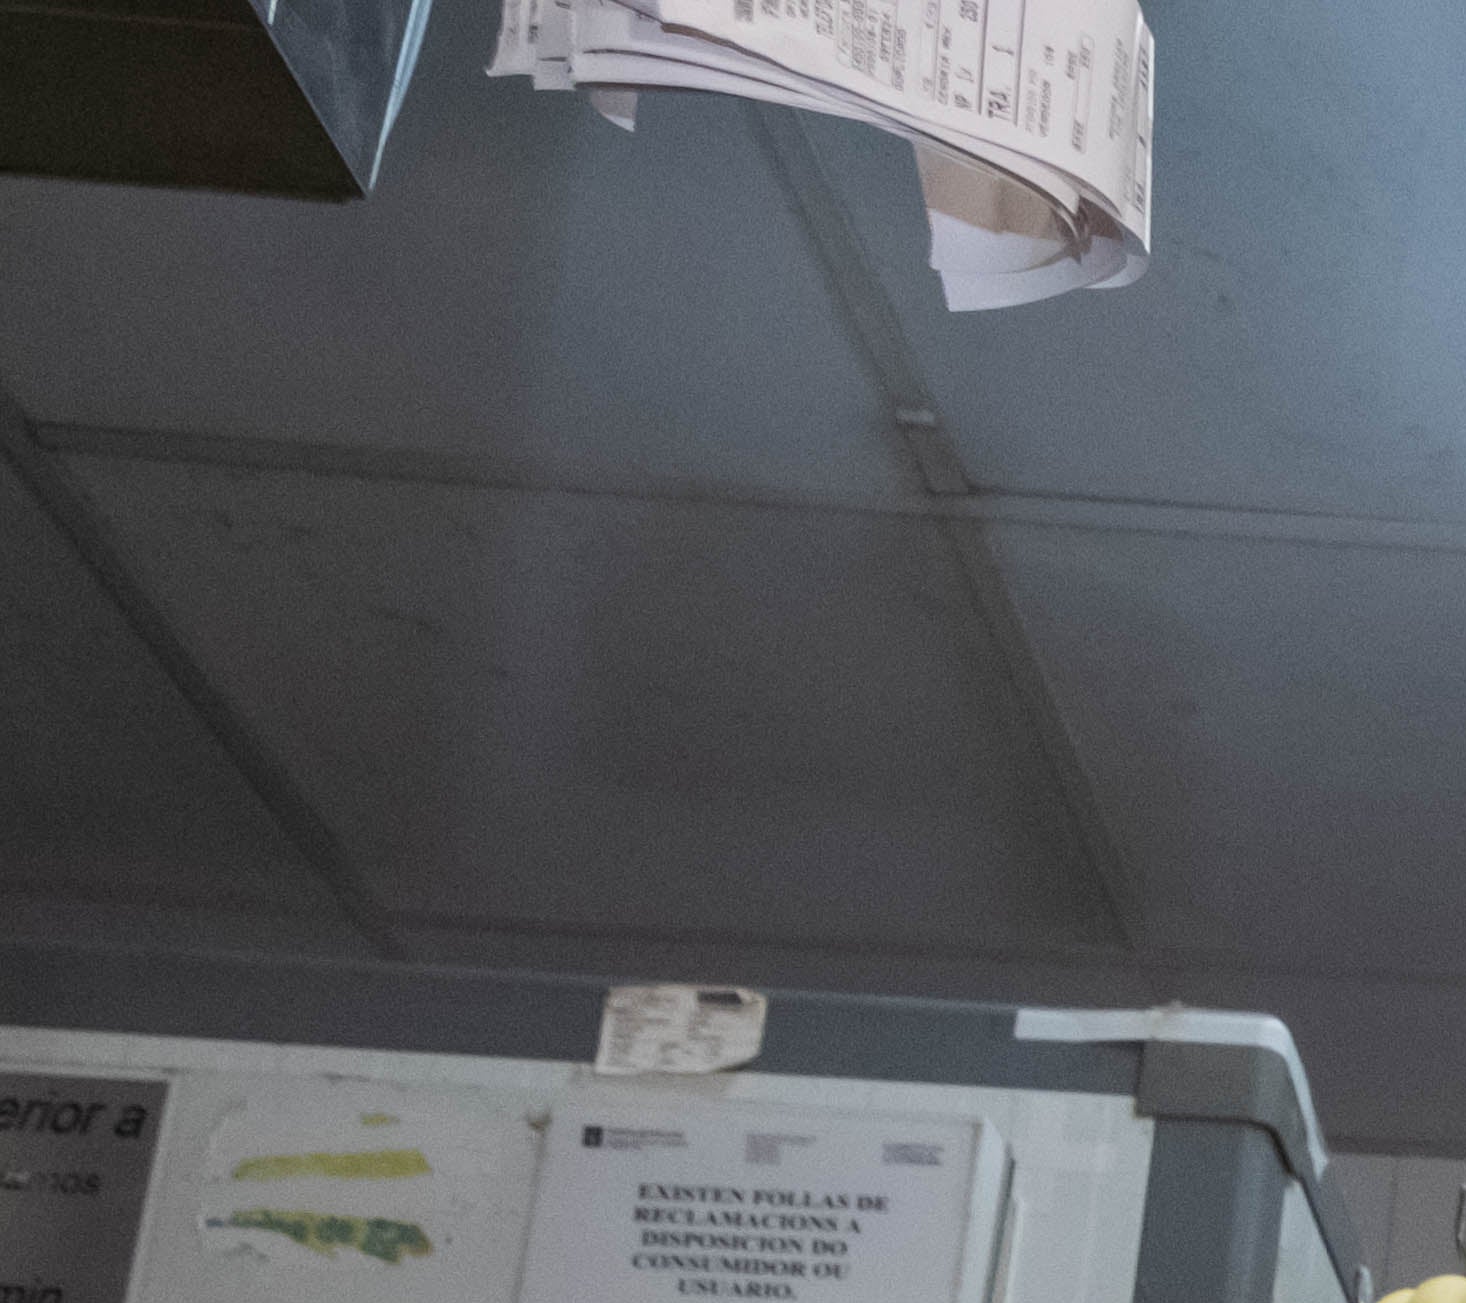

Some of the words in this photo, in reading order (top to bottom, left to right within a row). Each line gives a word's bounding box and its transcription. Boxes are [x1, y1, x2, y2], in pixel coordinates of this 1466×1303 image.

[113, 1104, 147, 1138] a
[637, 1183, 744, 1204] EXISTEN
[752, 1188, 850, 1210] FOLLAS
[856, 1194, 890, 1213] DE
[633, 1205, 840, 1233] RECLAMACIONS
[846, 1217, 862, 1235] A
[640, 1229, 803, 1254] DISPOSICION
[811, 1238, 849, 1256] DO
[630, 1252, 806, 1278] CONSUMIDOR
[812, 1261, 850, 1281] OU
